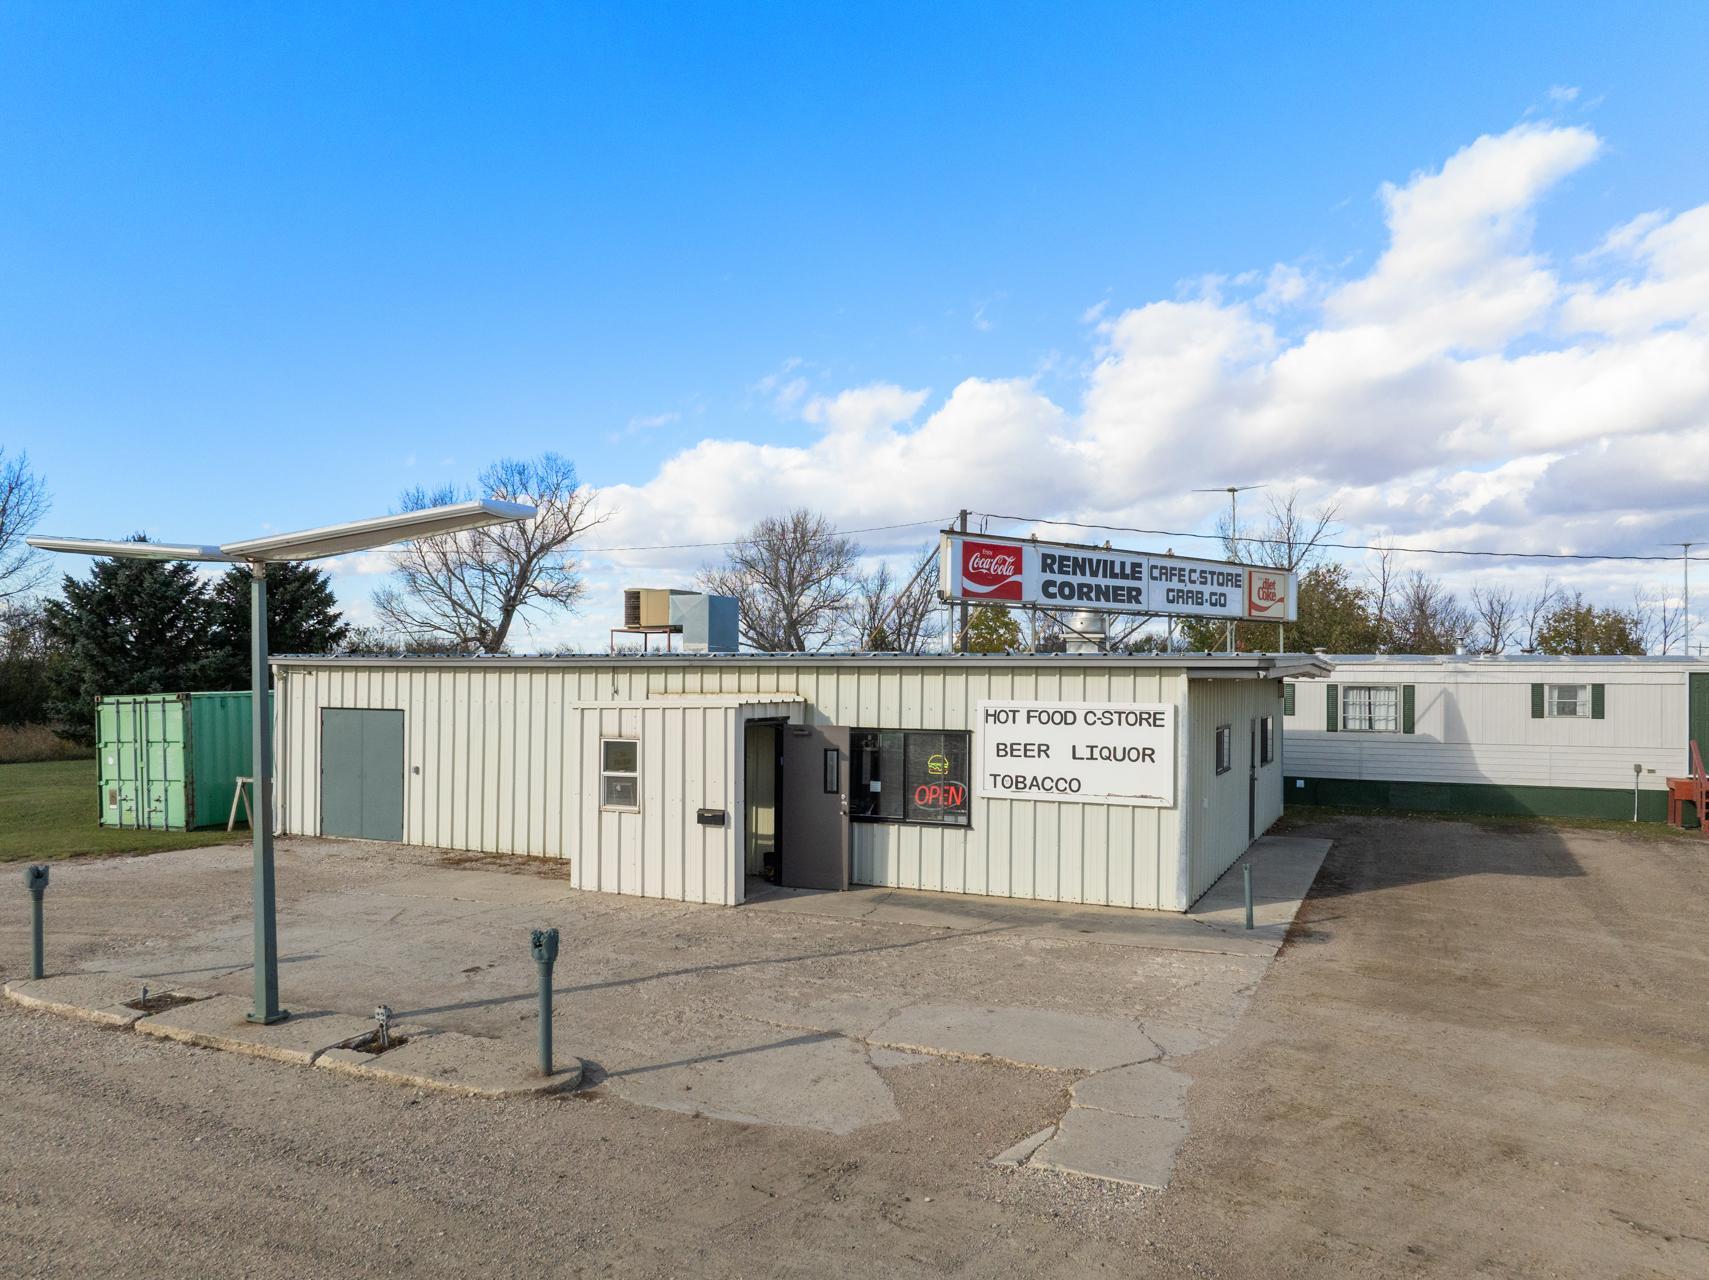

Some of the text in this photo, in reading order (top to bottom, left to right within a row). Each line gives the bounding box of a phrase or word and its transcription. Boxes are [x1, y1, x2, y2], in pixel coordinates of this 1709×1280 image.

[1041, 553, 1143, 581] RENVILLE
[1041, 579, 1143, 605] CORNER
[1257, 586, 1277, 601] Coke
[985, 709, 1166, 728] HOT FOOD C-STORE
[996, 742, 1156, 763] BEER LIQUOR
[989, 773, 1082, 793] TOBACCO
[915, 785, 963, 806] OPEN
